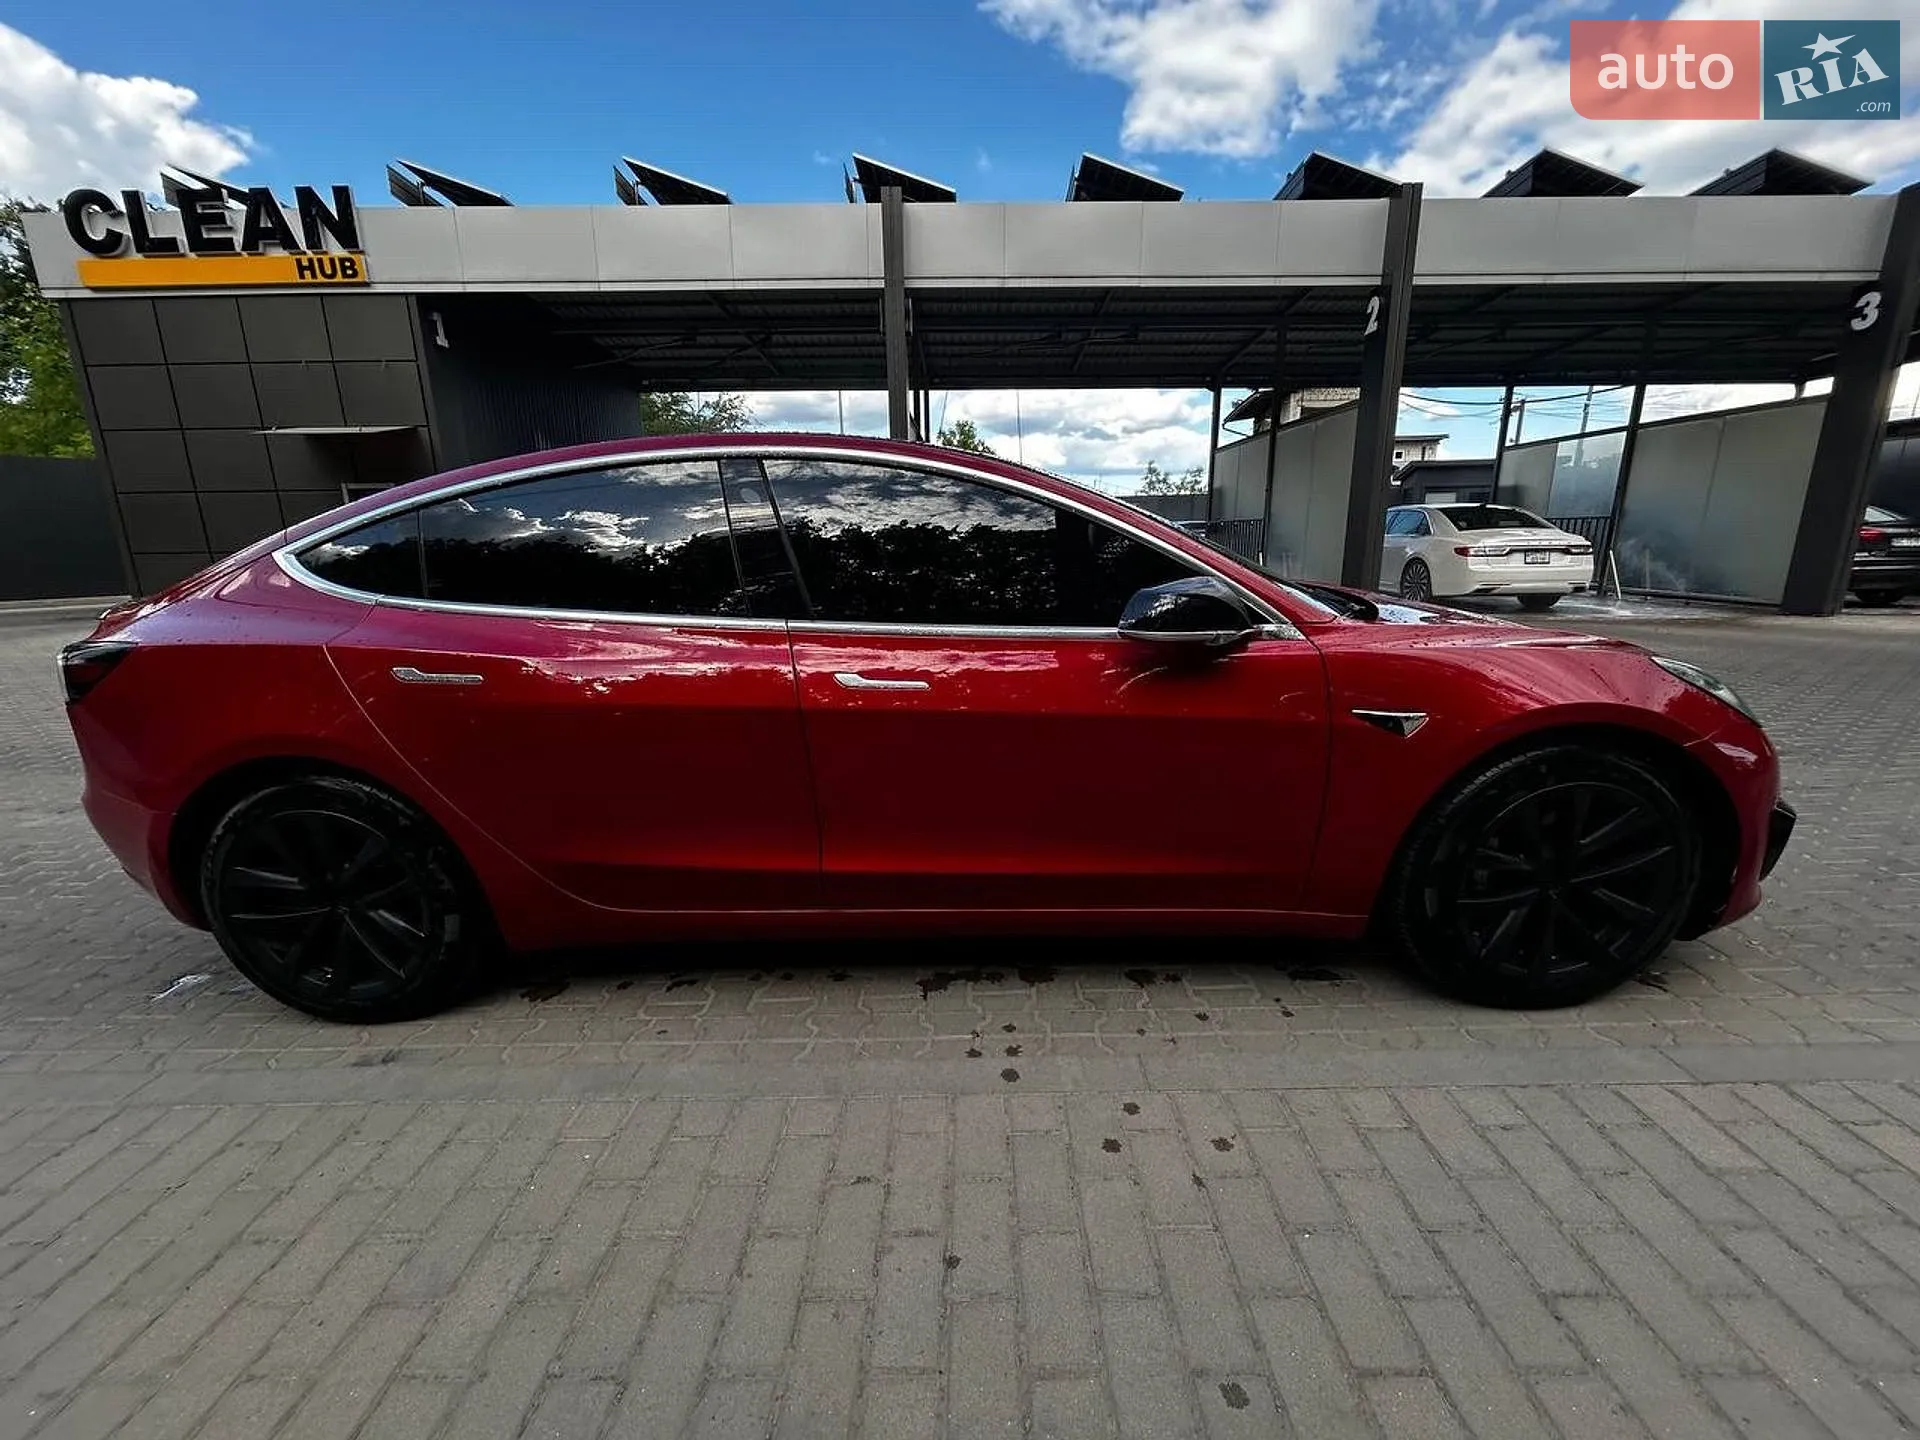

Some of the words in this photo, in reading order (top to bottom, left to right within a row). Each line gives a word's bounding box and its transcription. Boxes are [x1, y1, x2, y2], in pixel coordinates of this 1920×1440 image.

[63, 185, 364, 256] CLEAN
[296, 256, 360, 281] HUB
[431, 311, 450, 349] 1
[1364, 295, 1380, 336] 2
[1850, 291, 1882, 331] 3
